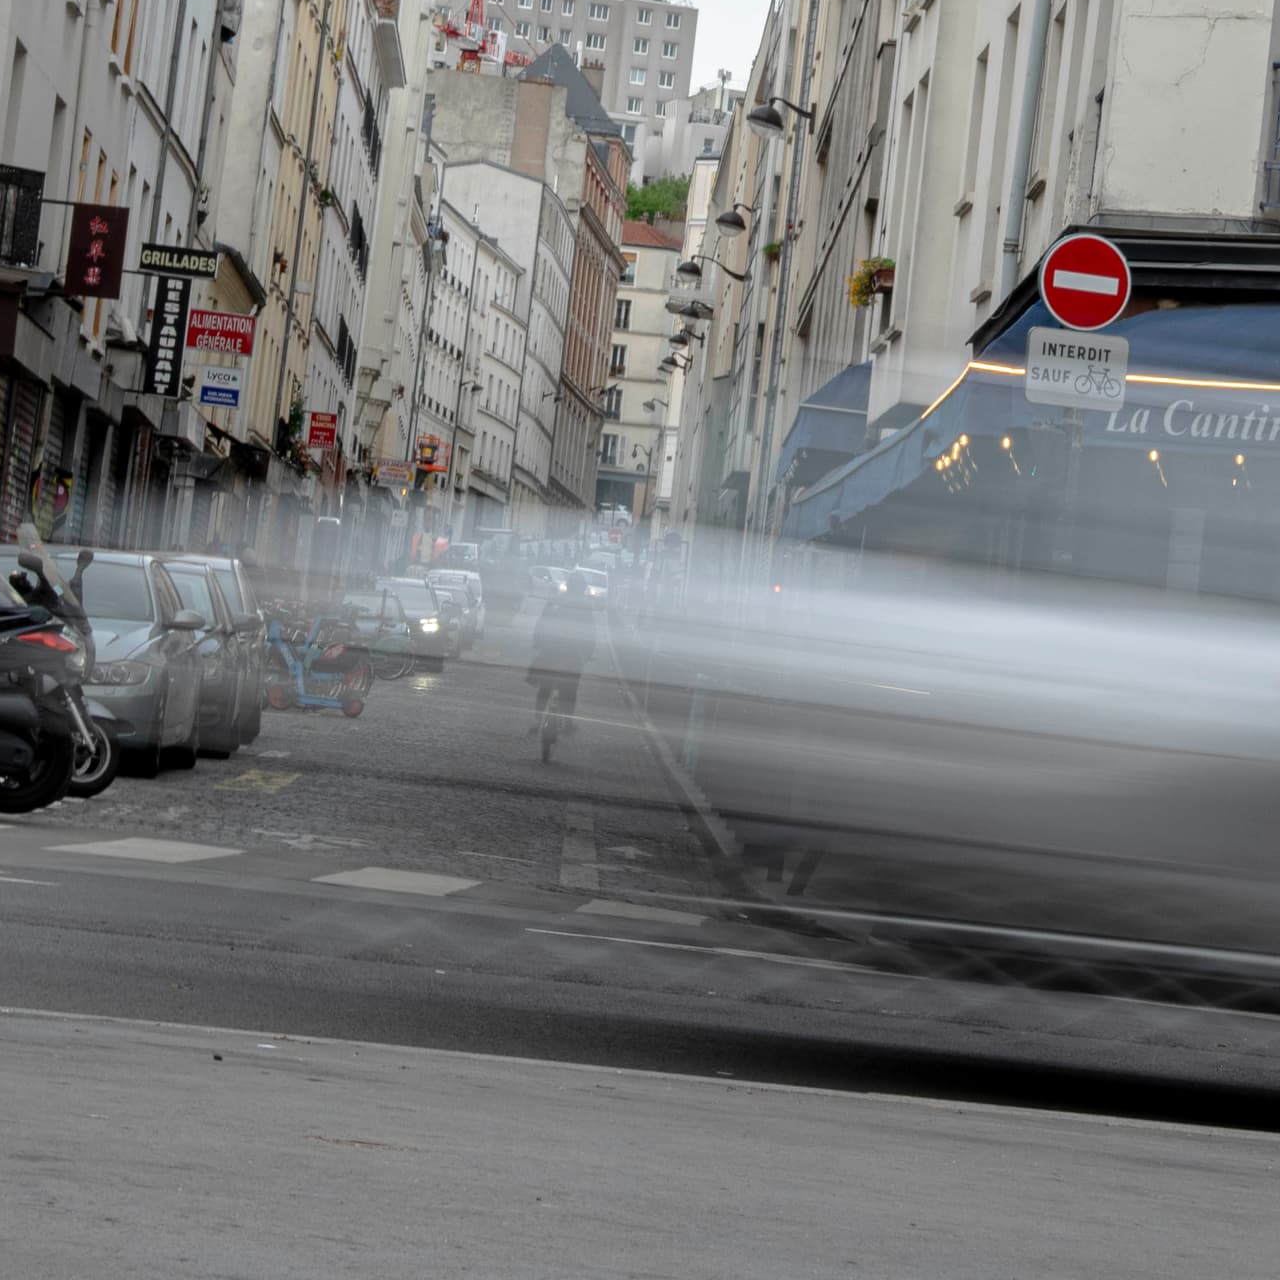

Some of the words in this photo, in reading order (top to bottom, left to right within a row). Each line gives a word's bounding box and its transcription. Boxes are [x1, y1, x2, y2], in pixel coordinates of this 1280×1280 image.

[141, 249, 216, 272] GRILLADES
[191, 313, 253, 333] ALIMENTATION
[154, 279, 183, 395] RESTAURANT
[196, 330, 243, 353] GÉNÉRALE
[1042, 341, 1112, 363] INTERDIT
[1031, 367, 1071, 383] SAUF
[1106, 406, 1151, 434] La
